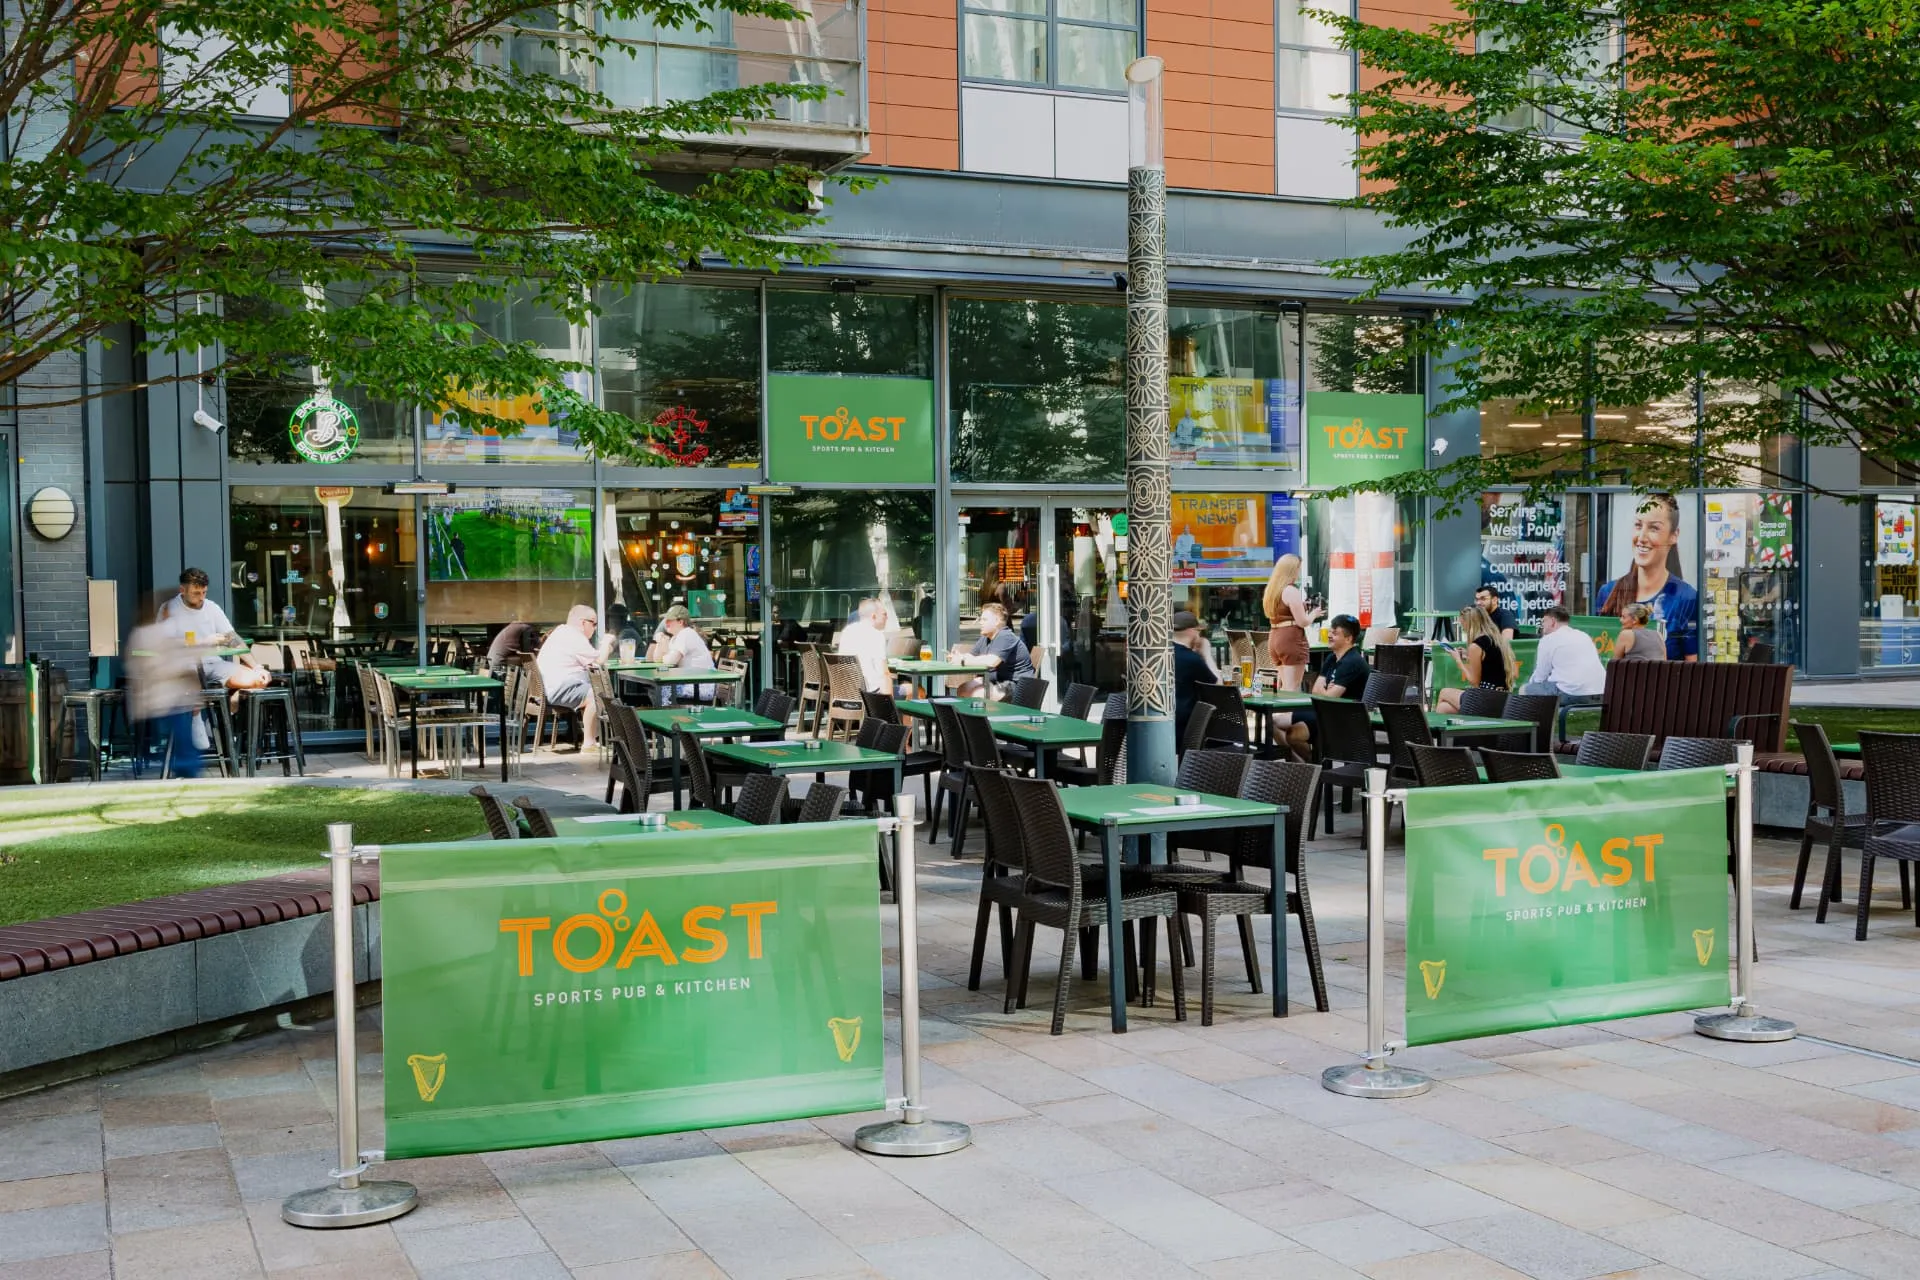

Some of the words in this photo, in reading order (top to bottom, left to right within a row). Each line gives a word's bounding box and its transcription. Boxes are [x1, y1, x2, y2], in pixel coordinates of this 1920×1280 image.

[295, 399, 352, 419] BROOKLYN
[799, 414, 906, 441] TOAST
[1323, 426, 1408, 449] TOAST
[296, 441, 352, 462] BREWERY
[1196, 513, 1238, 525] NEWS
[1489, 503, 1537, 522] Serving
[1489, 522, 1523, 537] West
[1527, 522, 1561, 537] Point
[1759, 521, 1776, 529] Come
[1777, 521, 1787, 529] on
[1759, 529, 1786, 538] England!
[1489, 561, 1571, 574] communities
[1516, 577, 1557, 597] planet
[1559, 580, 1567, 591] a
[1483, 833, 1664, 897] TOAST
[1505, 906, 1553, 922] SPORTS
[1557, 903, 1582, 917] PUB
[1586, 903, 1593, 914] &
[1598, 897, 1647, 913] KITCHEN
[499, 900, 778, 977] TOAST
[533, 988, 604, 1007] SPORTS
[612, 983, 647, 1000] PUB
[655, 982, 666, 997] &
[674, 976, 752, 996] KITCHEN
